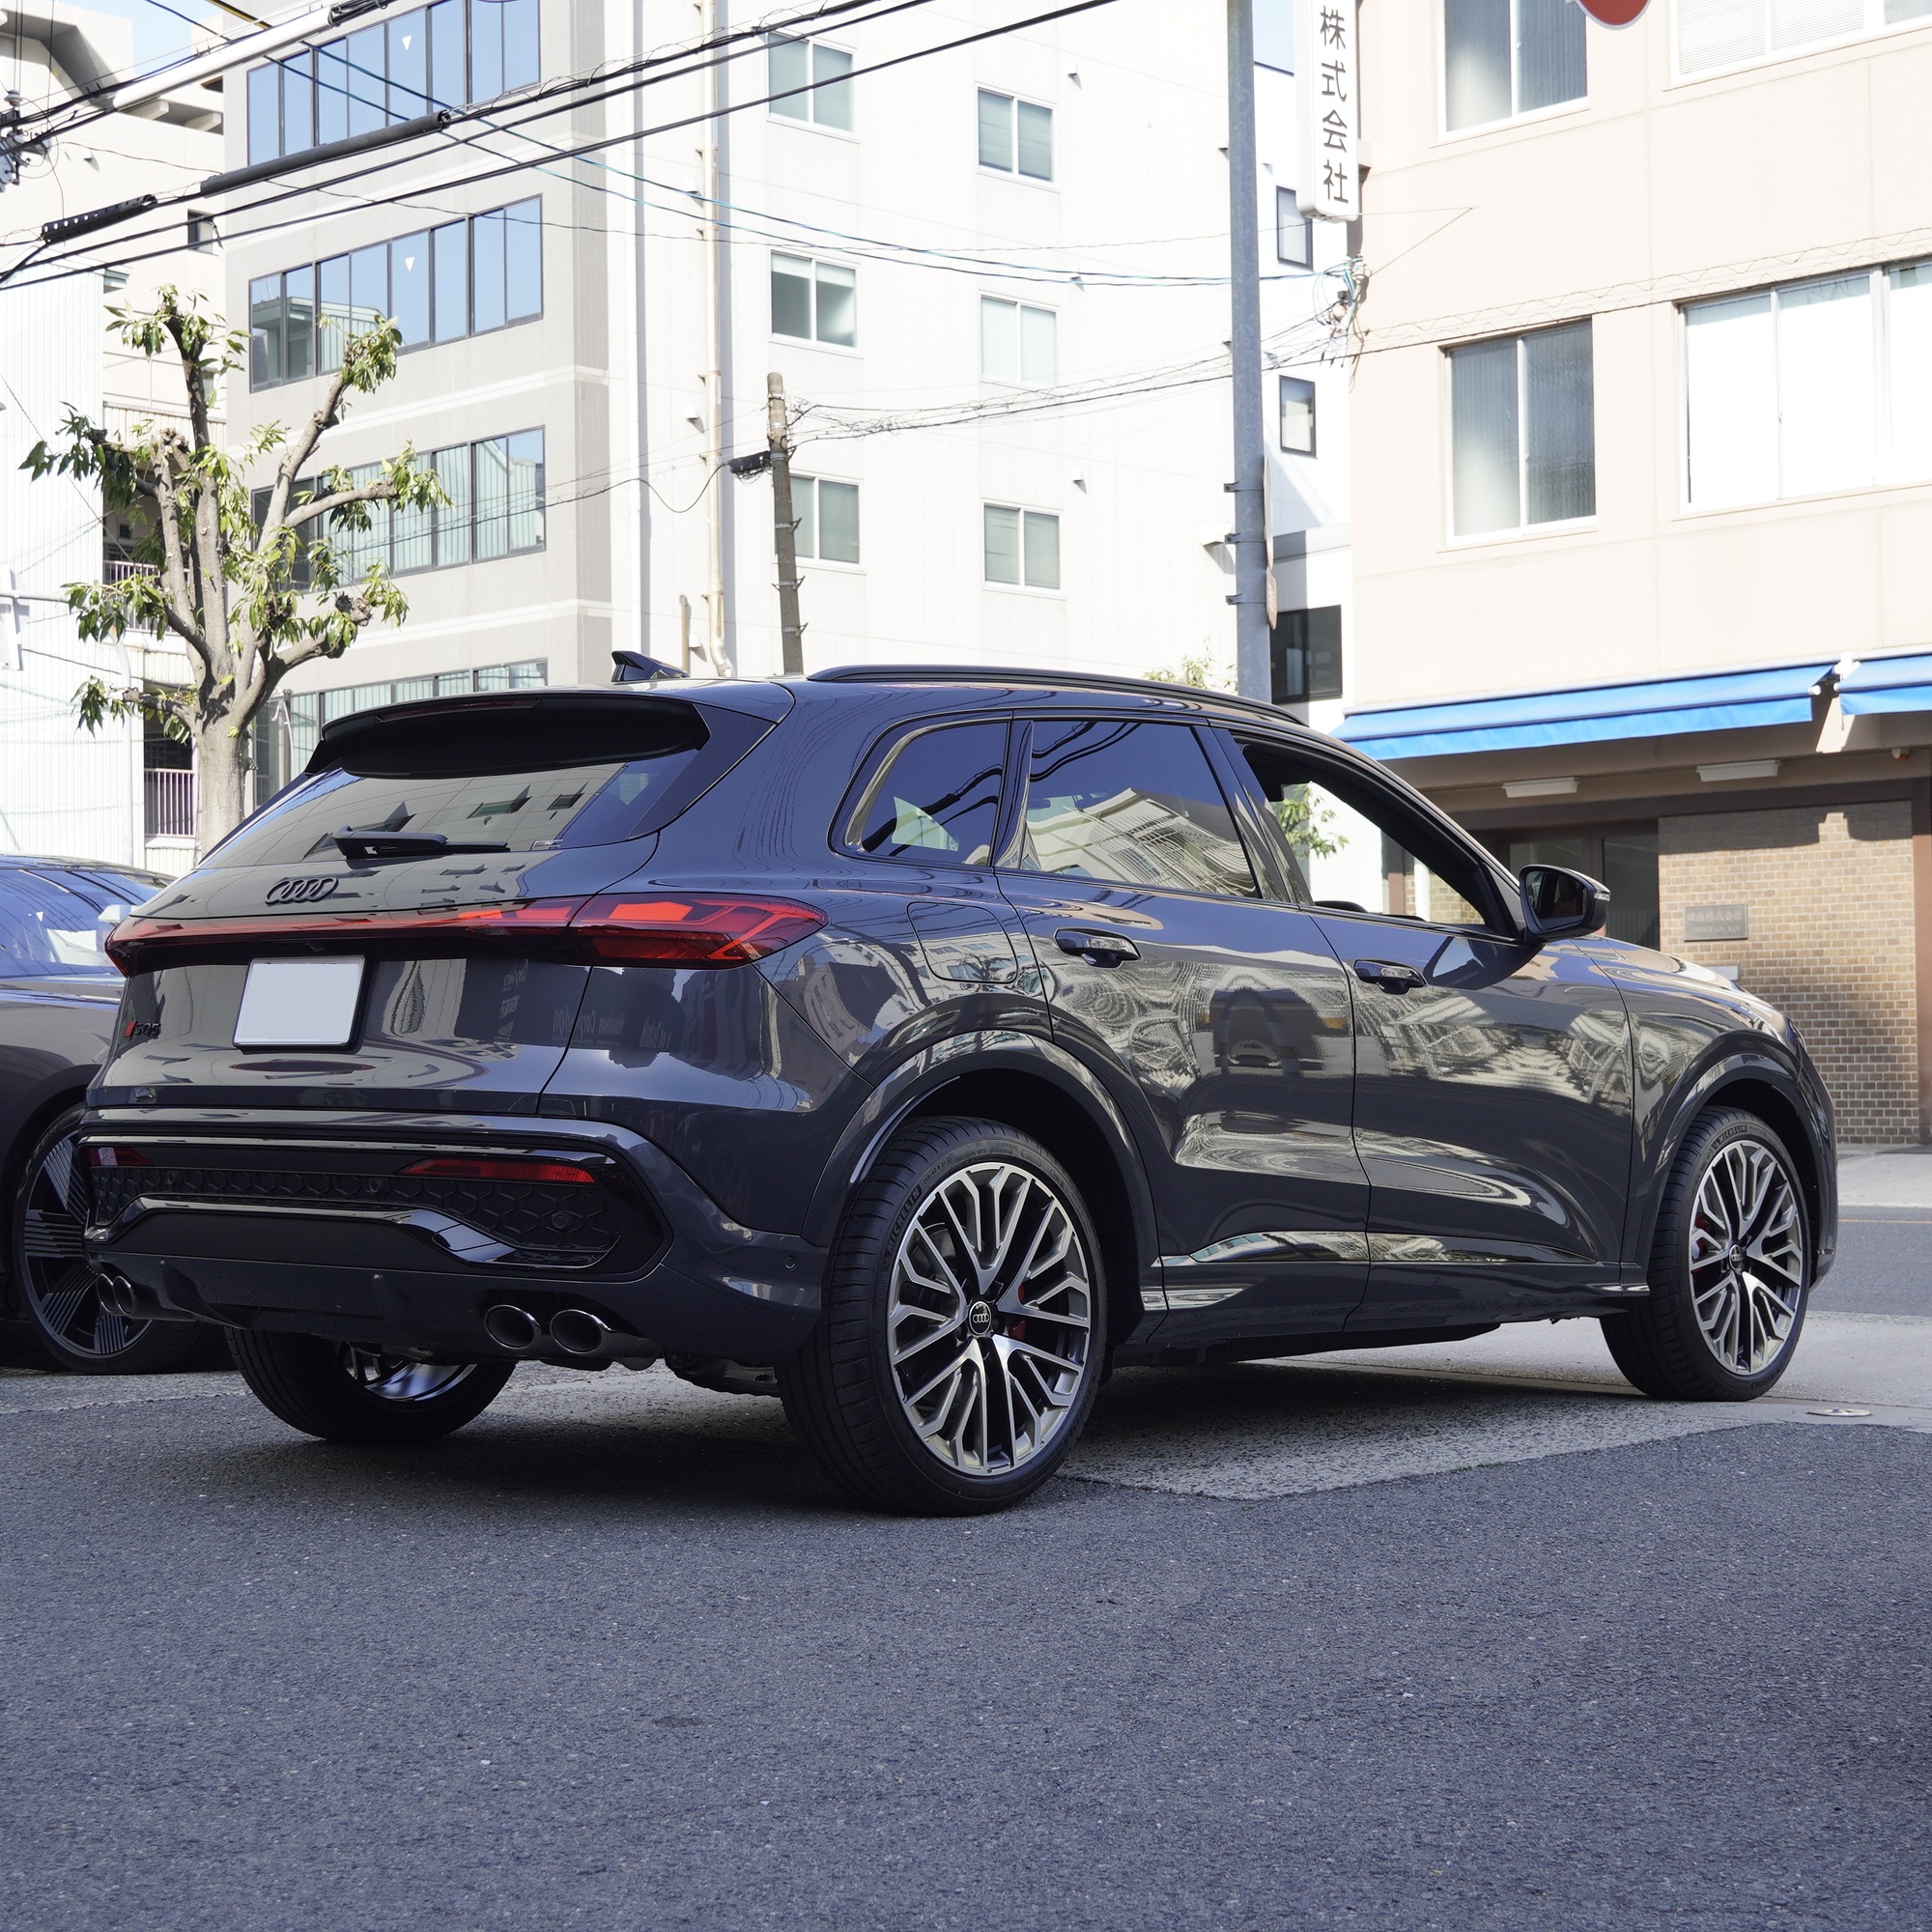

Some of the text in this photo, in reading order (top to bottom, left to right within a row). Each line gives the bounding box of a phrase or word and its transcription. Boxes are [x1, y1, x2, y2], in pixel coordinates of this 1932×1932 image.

[1320, 5, 1349, 204] 株式会社
[134, 1022, 160, 1037] SQ5
[1719, 1125, 1747, 1141] MICHELIN
[886, 1187, 921, 1254] MICHELIN
